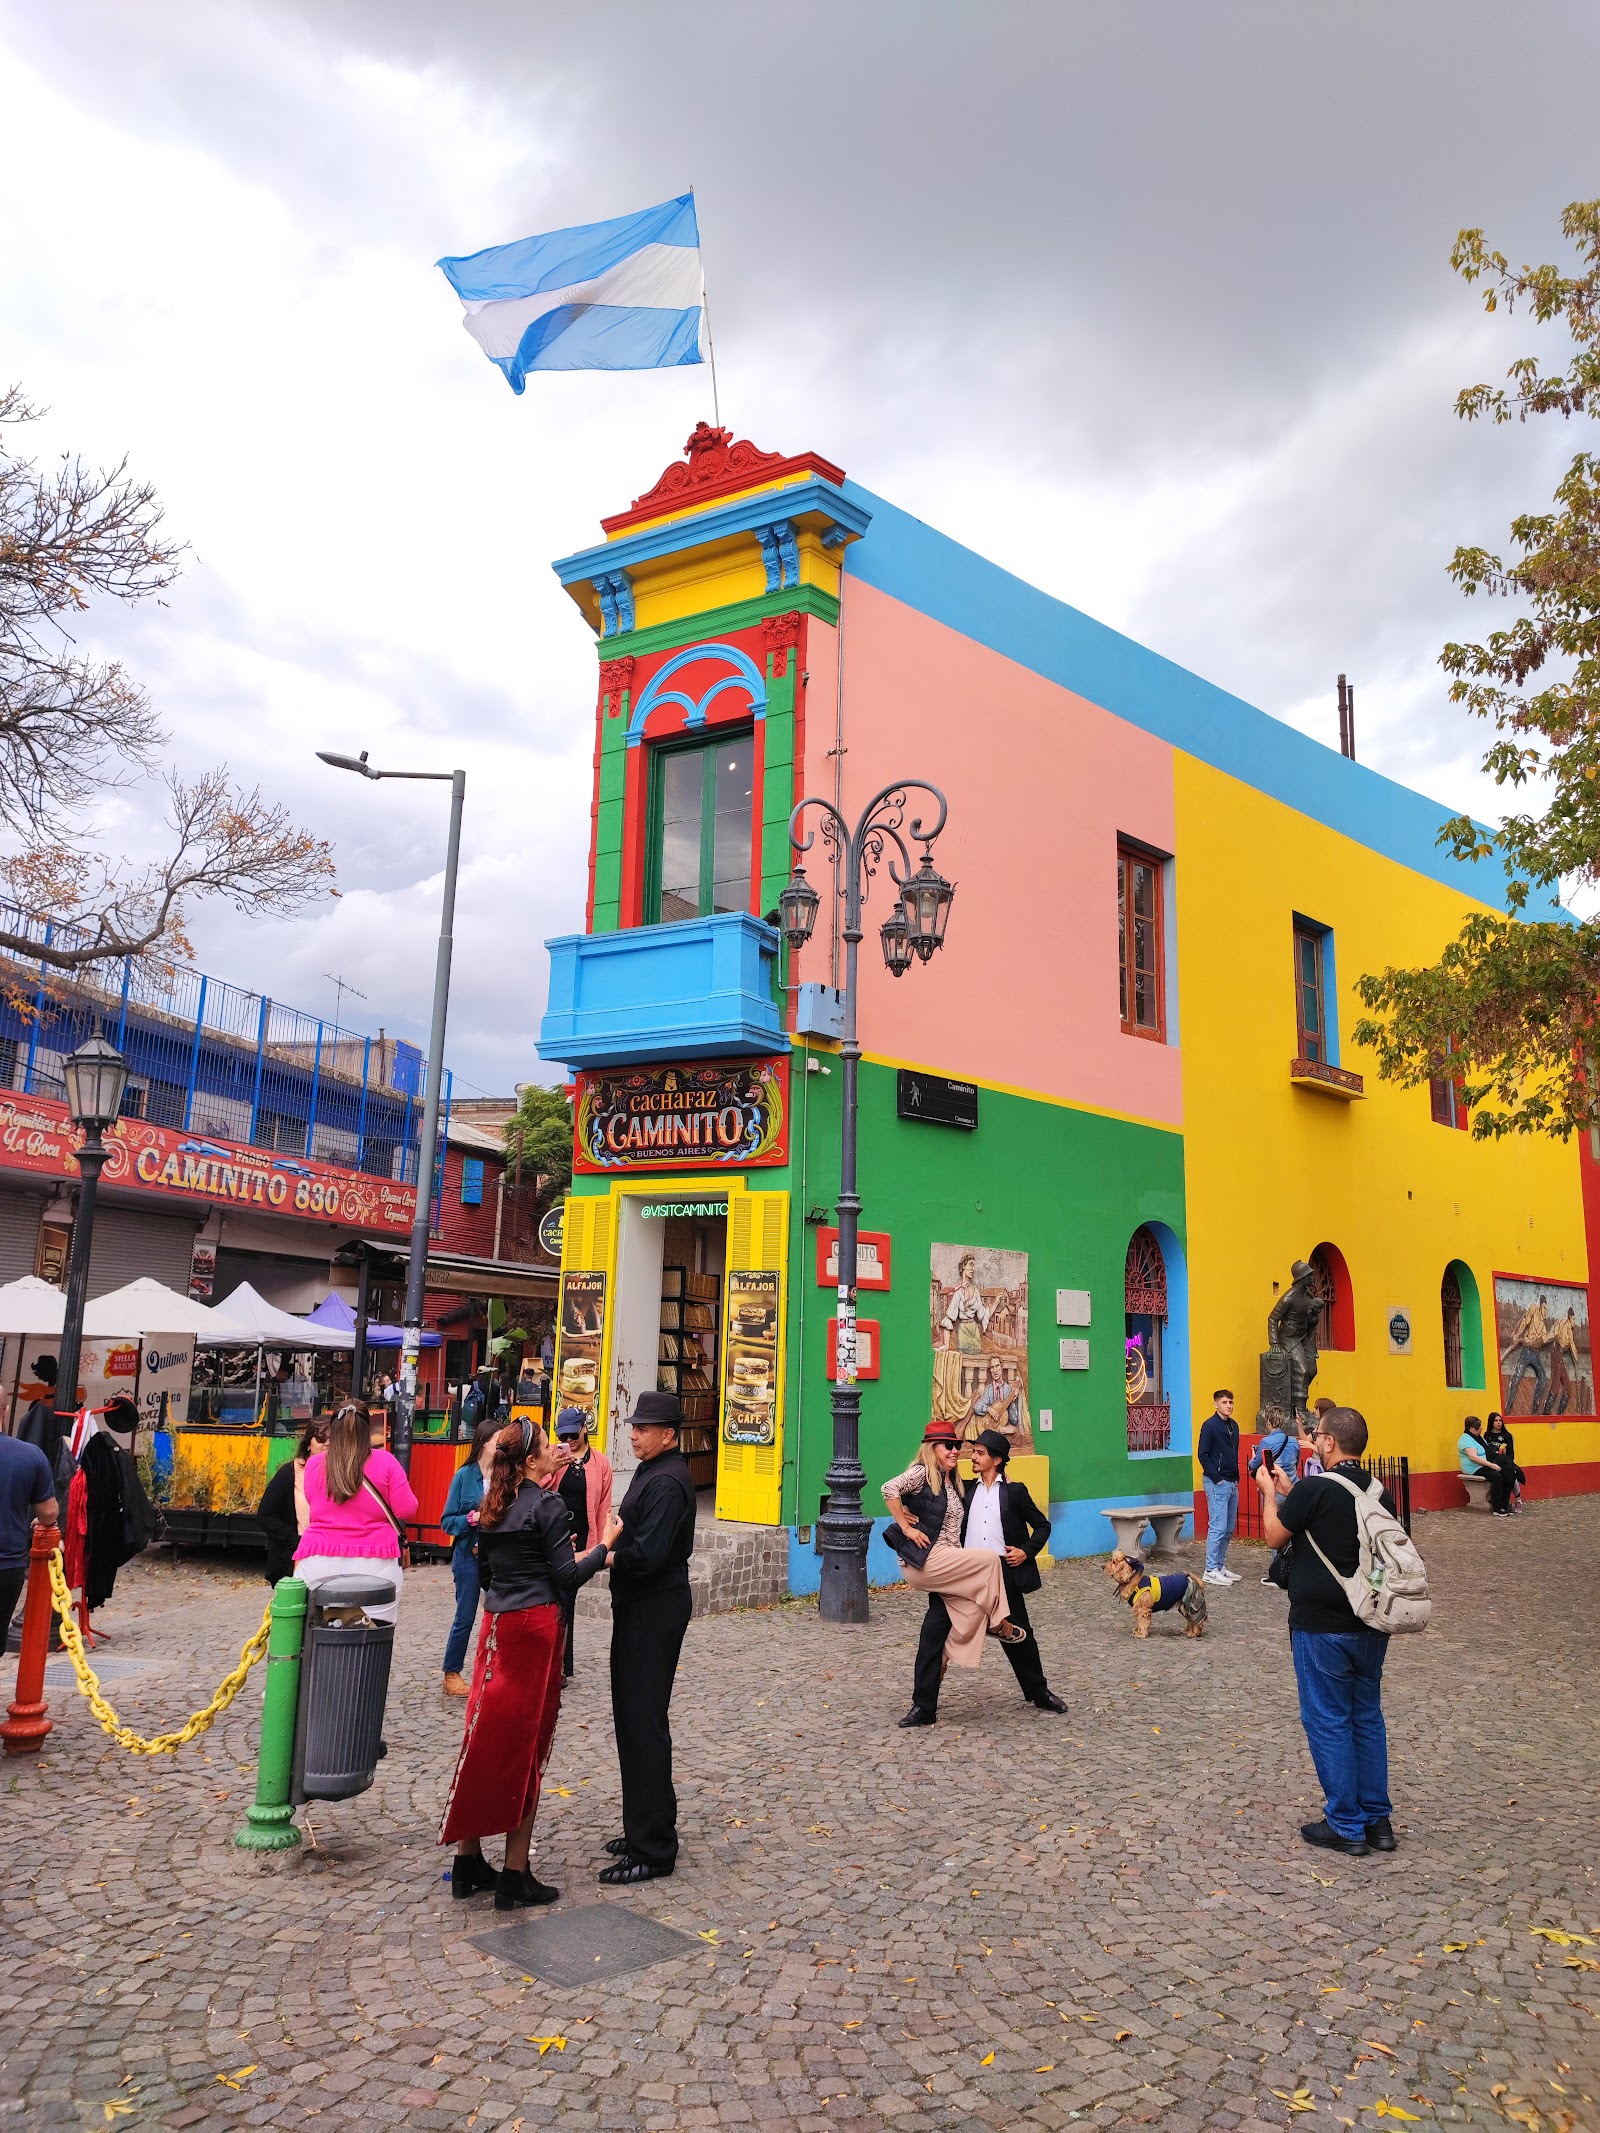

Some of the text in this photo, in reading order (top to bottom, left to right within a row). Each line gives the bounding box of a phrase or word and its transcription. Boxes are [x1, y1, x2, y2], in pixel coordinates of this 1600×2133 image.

[947, 1081, 975, 1095] Caminito
[606, 1106, 744, 1153] CAMINITO
[3, 1127, 60, 1157] La Boca
[234, 1149, 270, 1168] PASEO
[637, 1147, 707, 1158] BUENOS AIRES
[136, 1147, 339, 1215] CAMINITO 830
[641, 1203, 729, 1219] @VISITCAMINITO
[566, 1281, 602, 1290] ALFAJOR
[734, 1282, 775, 1291] ALFAJOR
[114, 1354, 136, 1362] STELLA
[146, 1349, 188, 1374] Quilmes
[112, 1362, 137, 1371] ARTOIS
[737, 1413, 762, 1425] CAFE
